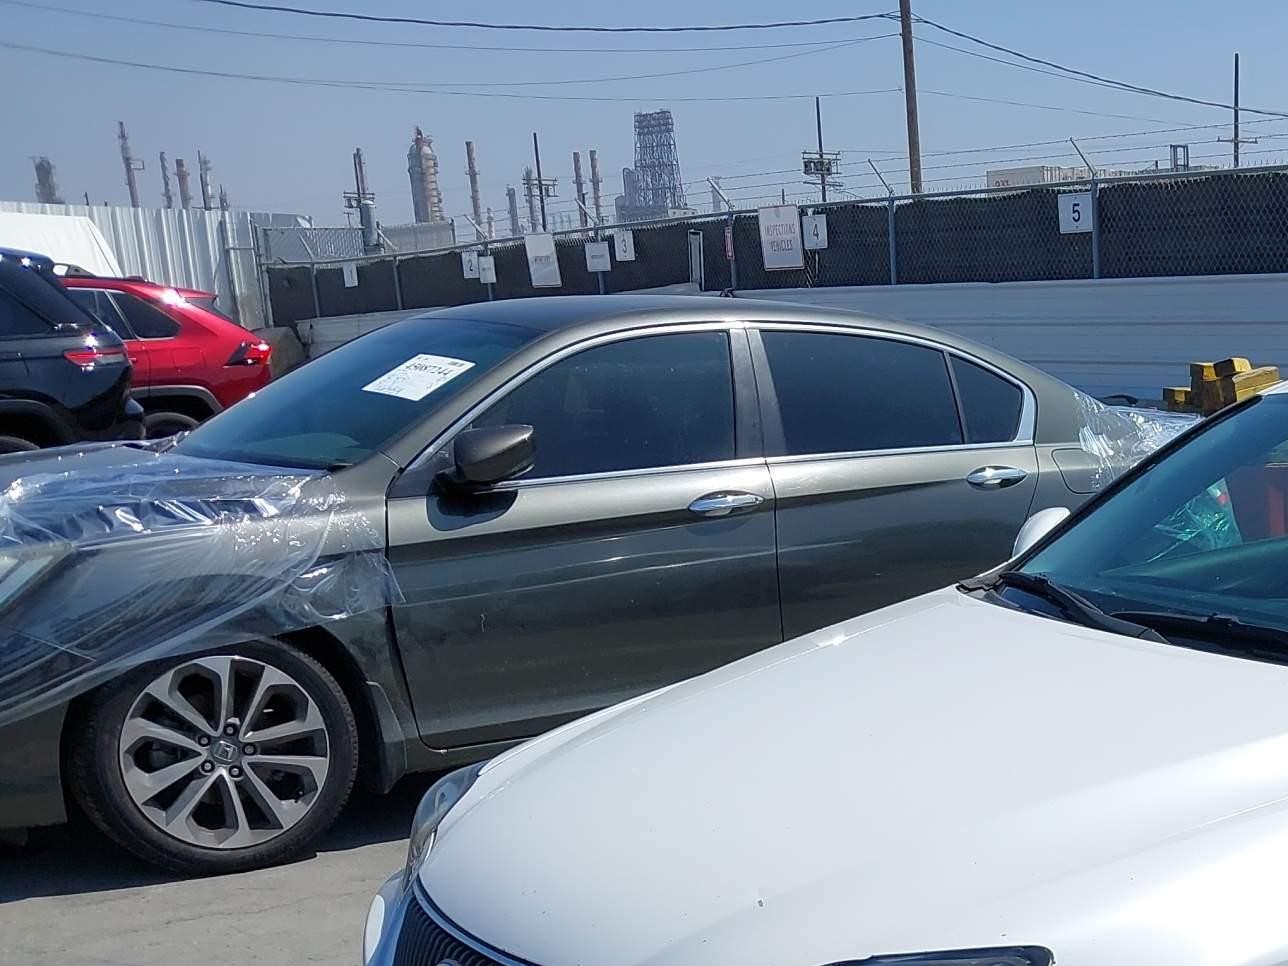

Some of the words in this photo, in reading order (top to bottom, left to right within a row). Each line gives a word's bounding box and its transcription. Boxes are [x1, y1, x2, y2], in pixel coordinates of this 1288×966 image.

[1072, 202, 1082, 223] 5
[764, 223, 796, 236] INSPECTIONS
[812, 223, 820, 241] 4
[621, 239, 628, 253] 3
[468, 258, 474, 272] 2
